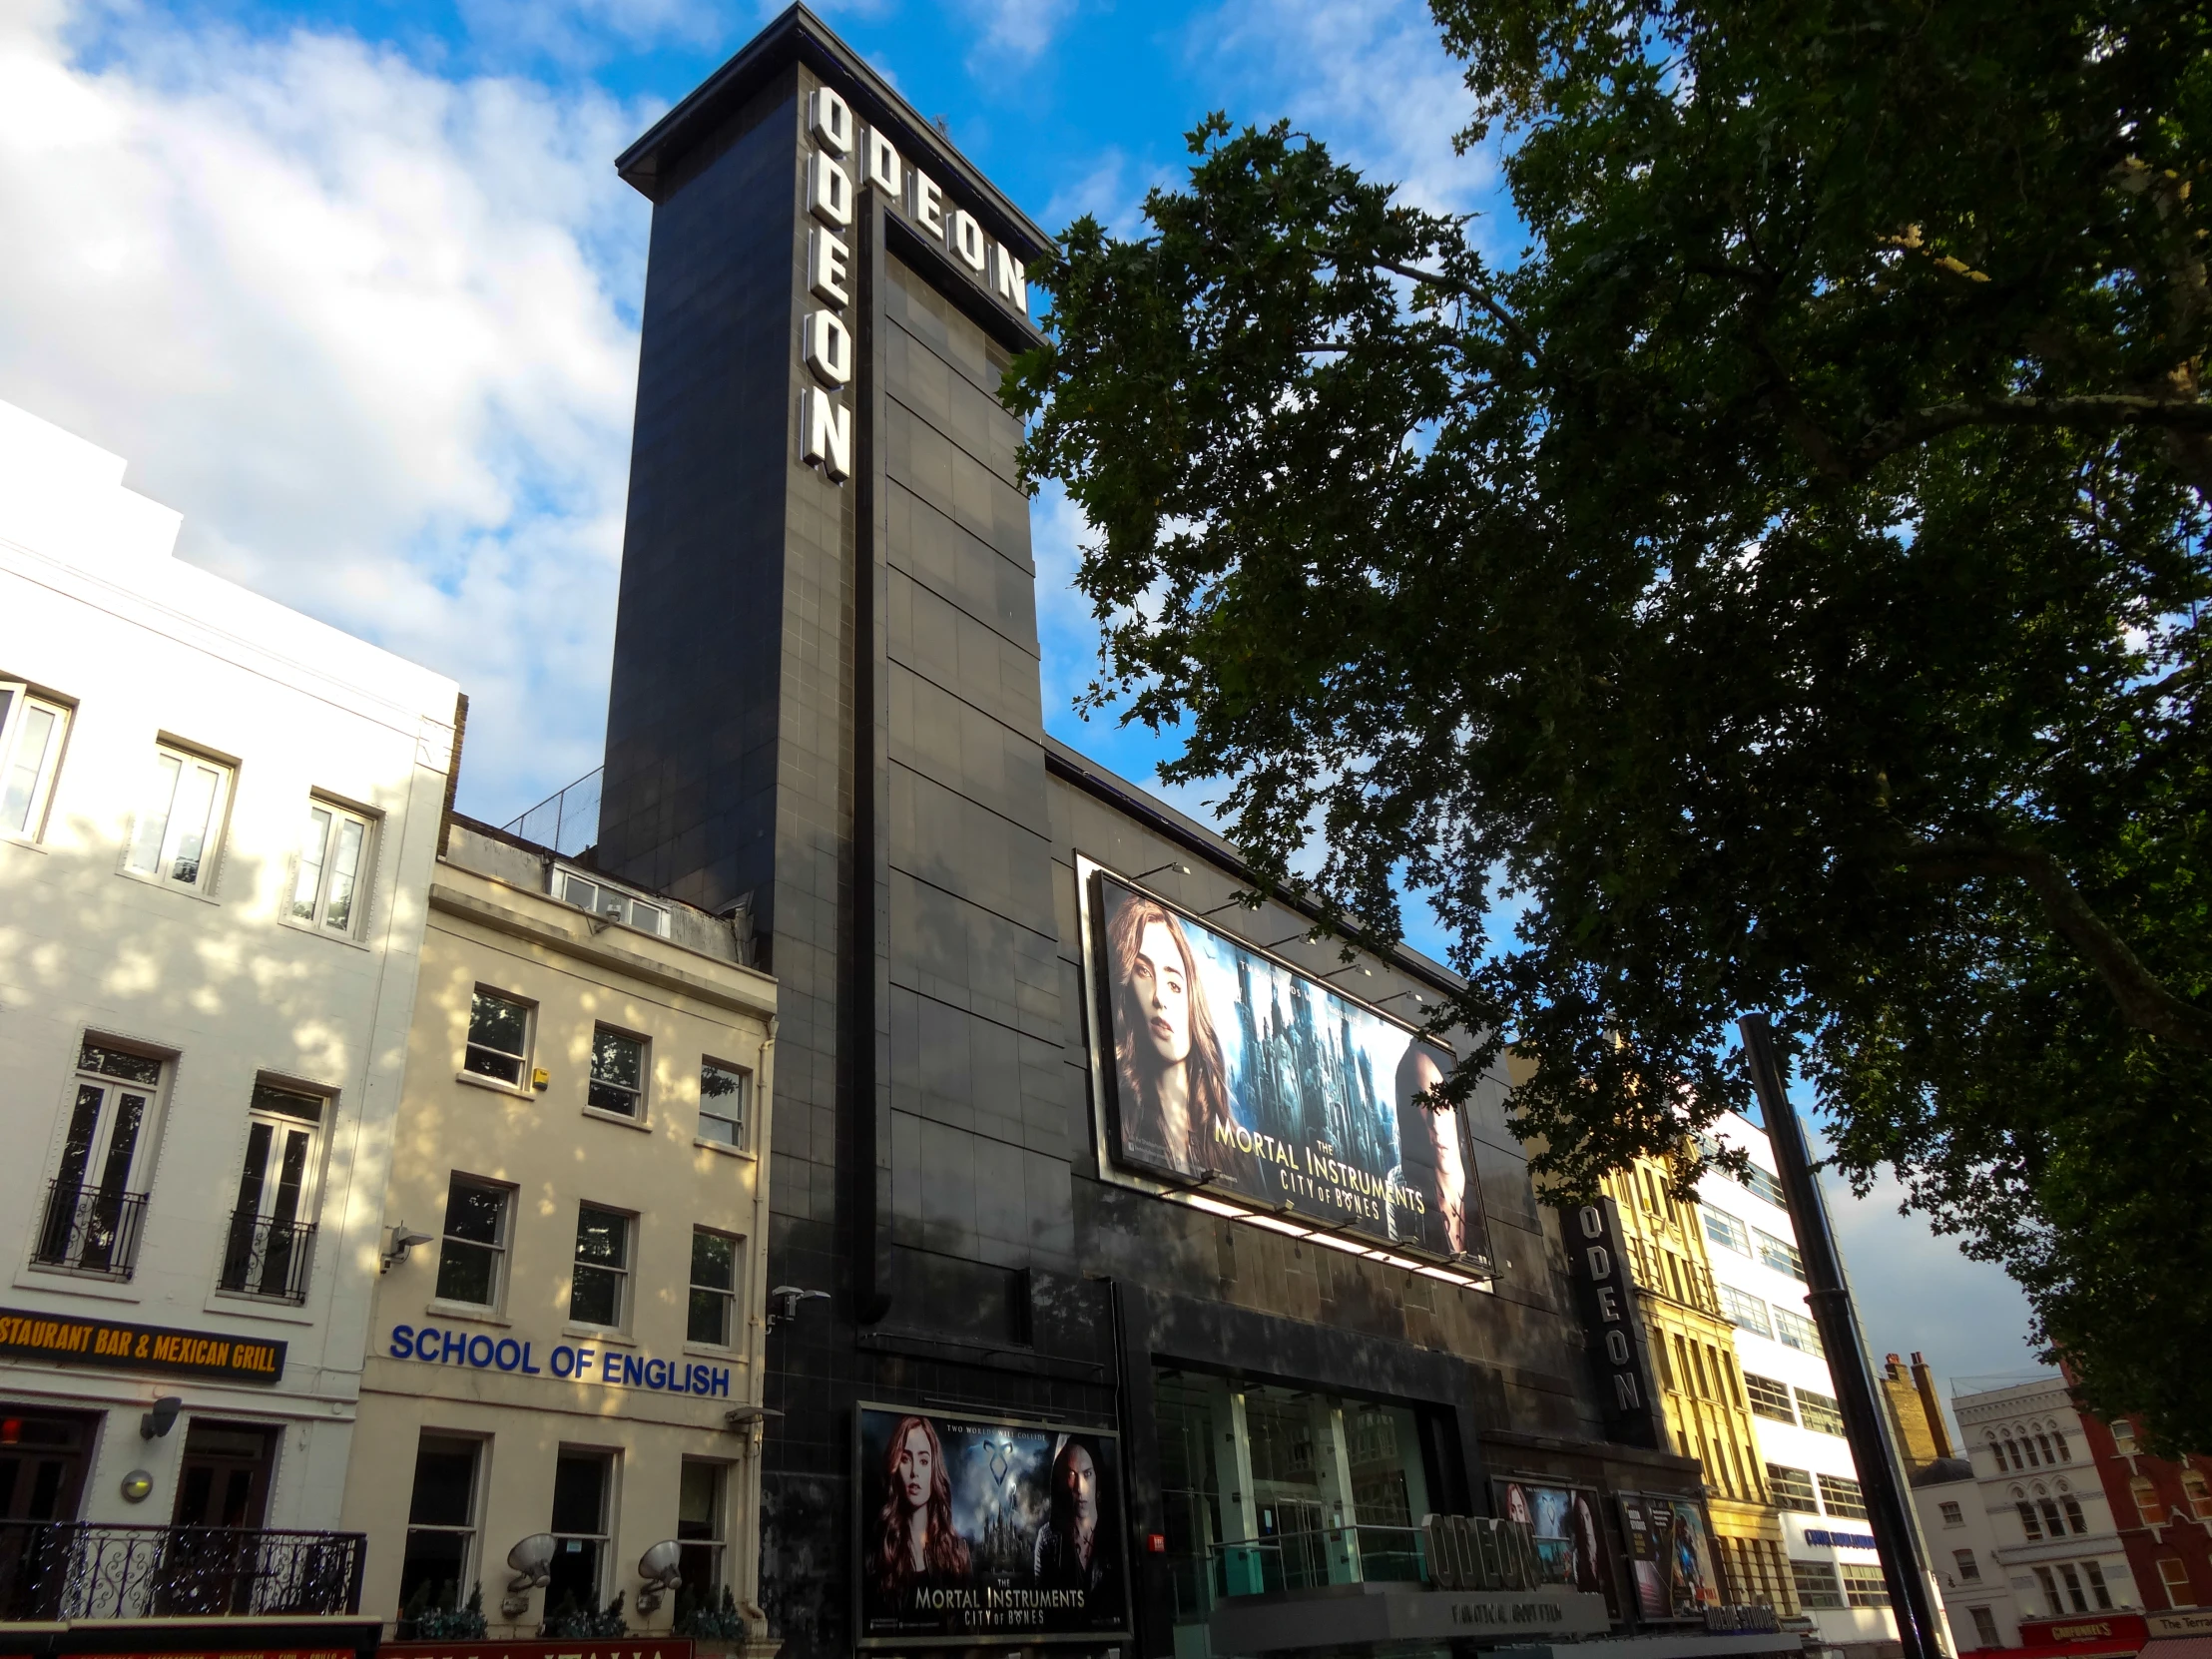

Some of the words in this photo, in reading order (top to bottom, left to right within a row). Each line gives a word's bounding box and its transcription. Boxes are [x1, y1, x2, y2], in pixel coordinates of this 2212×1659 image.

[803, 86, 852, 484] ODEON
[1215, 1113, 1299, 1171] MORTAL
[1306, 1147, 1426, 1215] INSTRUMENTS
[1317, 1140, 1334, 1156] THE
[1280, 1169, 1314, 1198] CITY
[1335, 1188, 1380, 1221] BONES
[1579, 1205, 1640, 1411] ODEON
[94, 1328, 136, 1358] BAR
[135, 1334, 150, 1359] &
[153, 1335, 230, 1367] MEXICAN
[232, 1344, 276, 1373] GRILL
[389, 1325, 540, 1375] SCHOOL
[551, 1346, 595, 1380] OF
[602, 1352, 730, 1397] ENGLISH
[946, 1424, 963, 1433] TWO
[965, 1426, 995, 1435] WORLDS
[998, 1429, 1014, 1438] WILL
[1017, 1432, 1046, 1441] COLLIDE
[915, 1586, 980, 1610] MORTAL
[987, 1585, 1085, 1609] INSTRUMENTS
[998, 1578, 1010, 1588] THE
[964, 1609, 991, 1626] CITY
[1008, 1609, 1044, 1626] BONES
[2160, 1619, 2182, 1629] The
